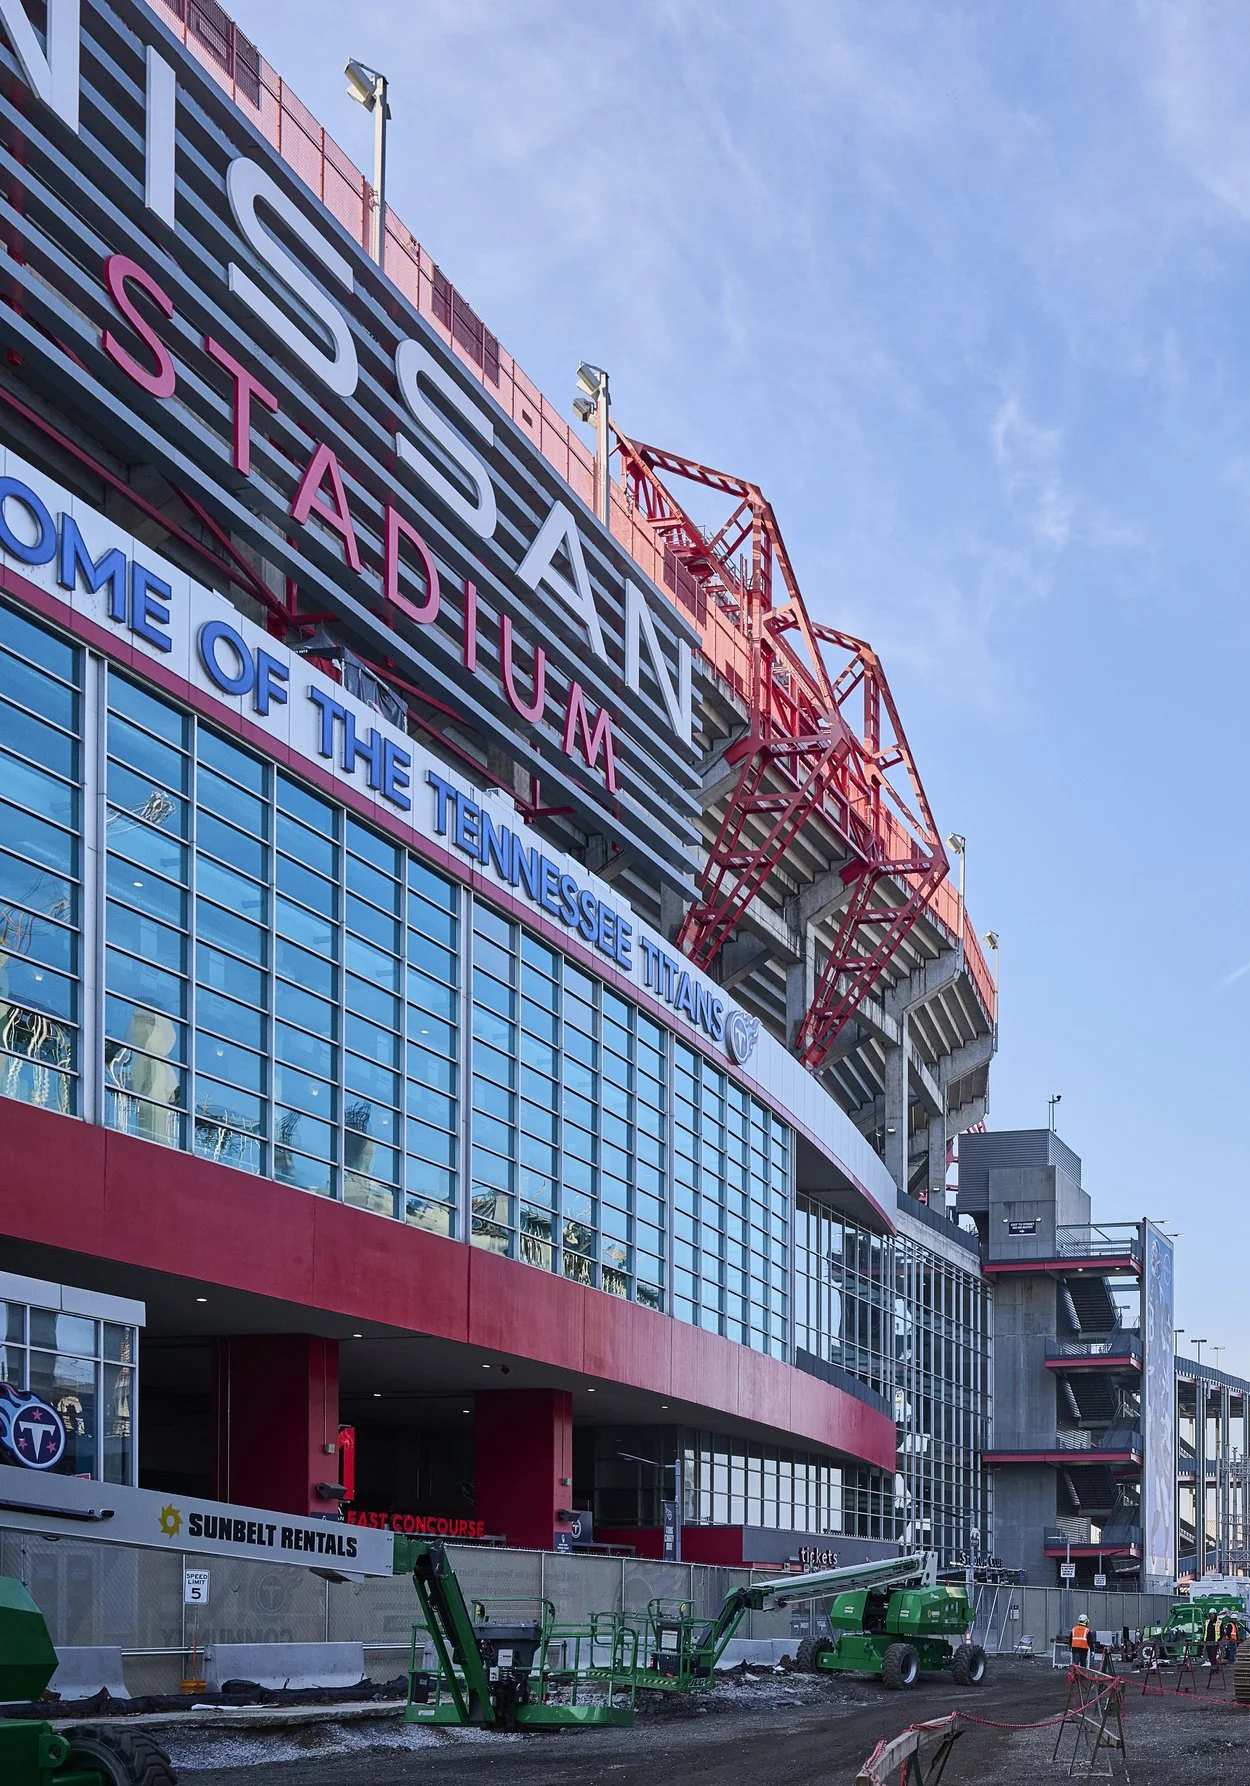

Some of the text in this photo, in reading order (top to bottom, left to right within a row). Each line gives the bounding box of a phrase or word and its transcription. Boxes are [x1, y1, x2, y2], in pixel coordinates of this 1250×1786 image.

[102, 254, 616, 795] STADIUM
[198, 620, 290, 716] OF
[307, 685, 411, 812] THE
[425, 769, 632, 971] TENNESSEE
[639, 935, 724, 1042] TITANS
[188, 1513, 358, 1558] SUNBELT RENTALS
[347, 1511, 484, 1537] EAST CONCOURSE
[800, 1547, 838, 1565] tickets
[191, 1588, 201, 1599] 5
